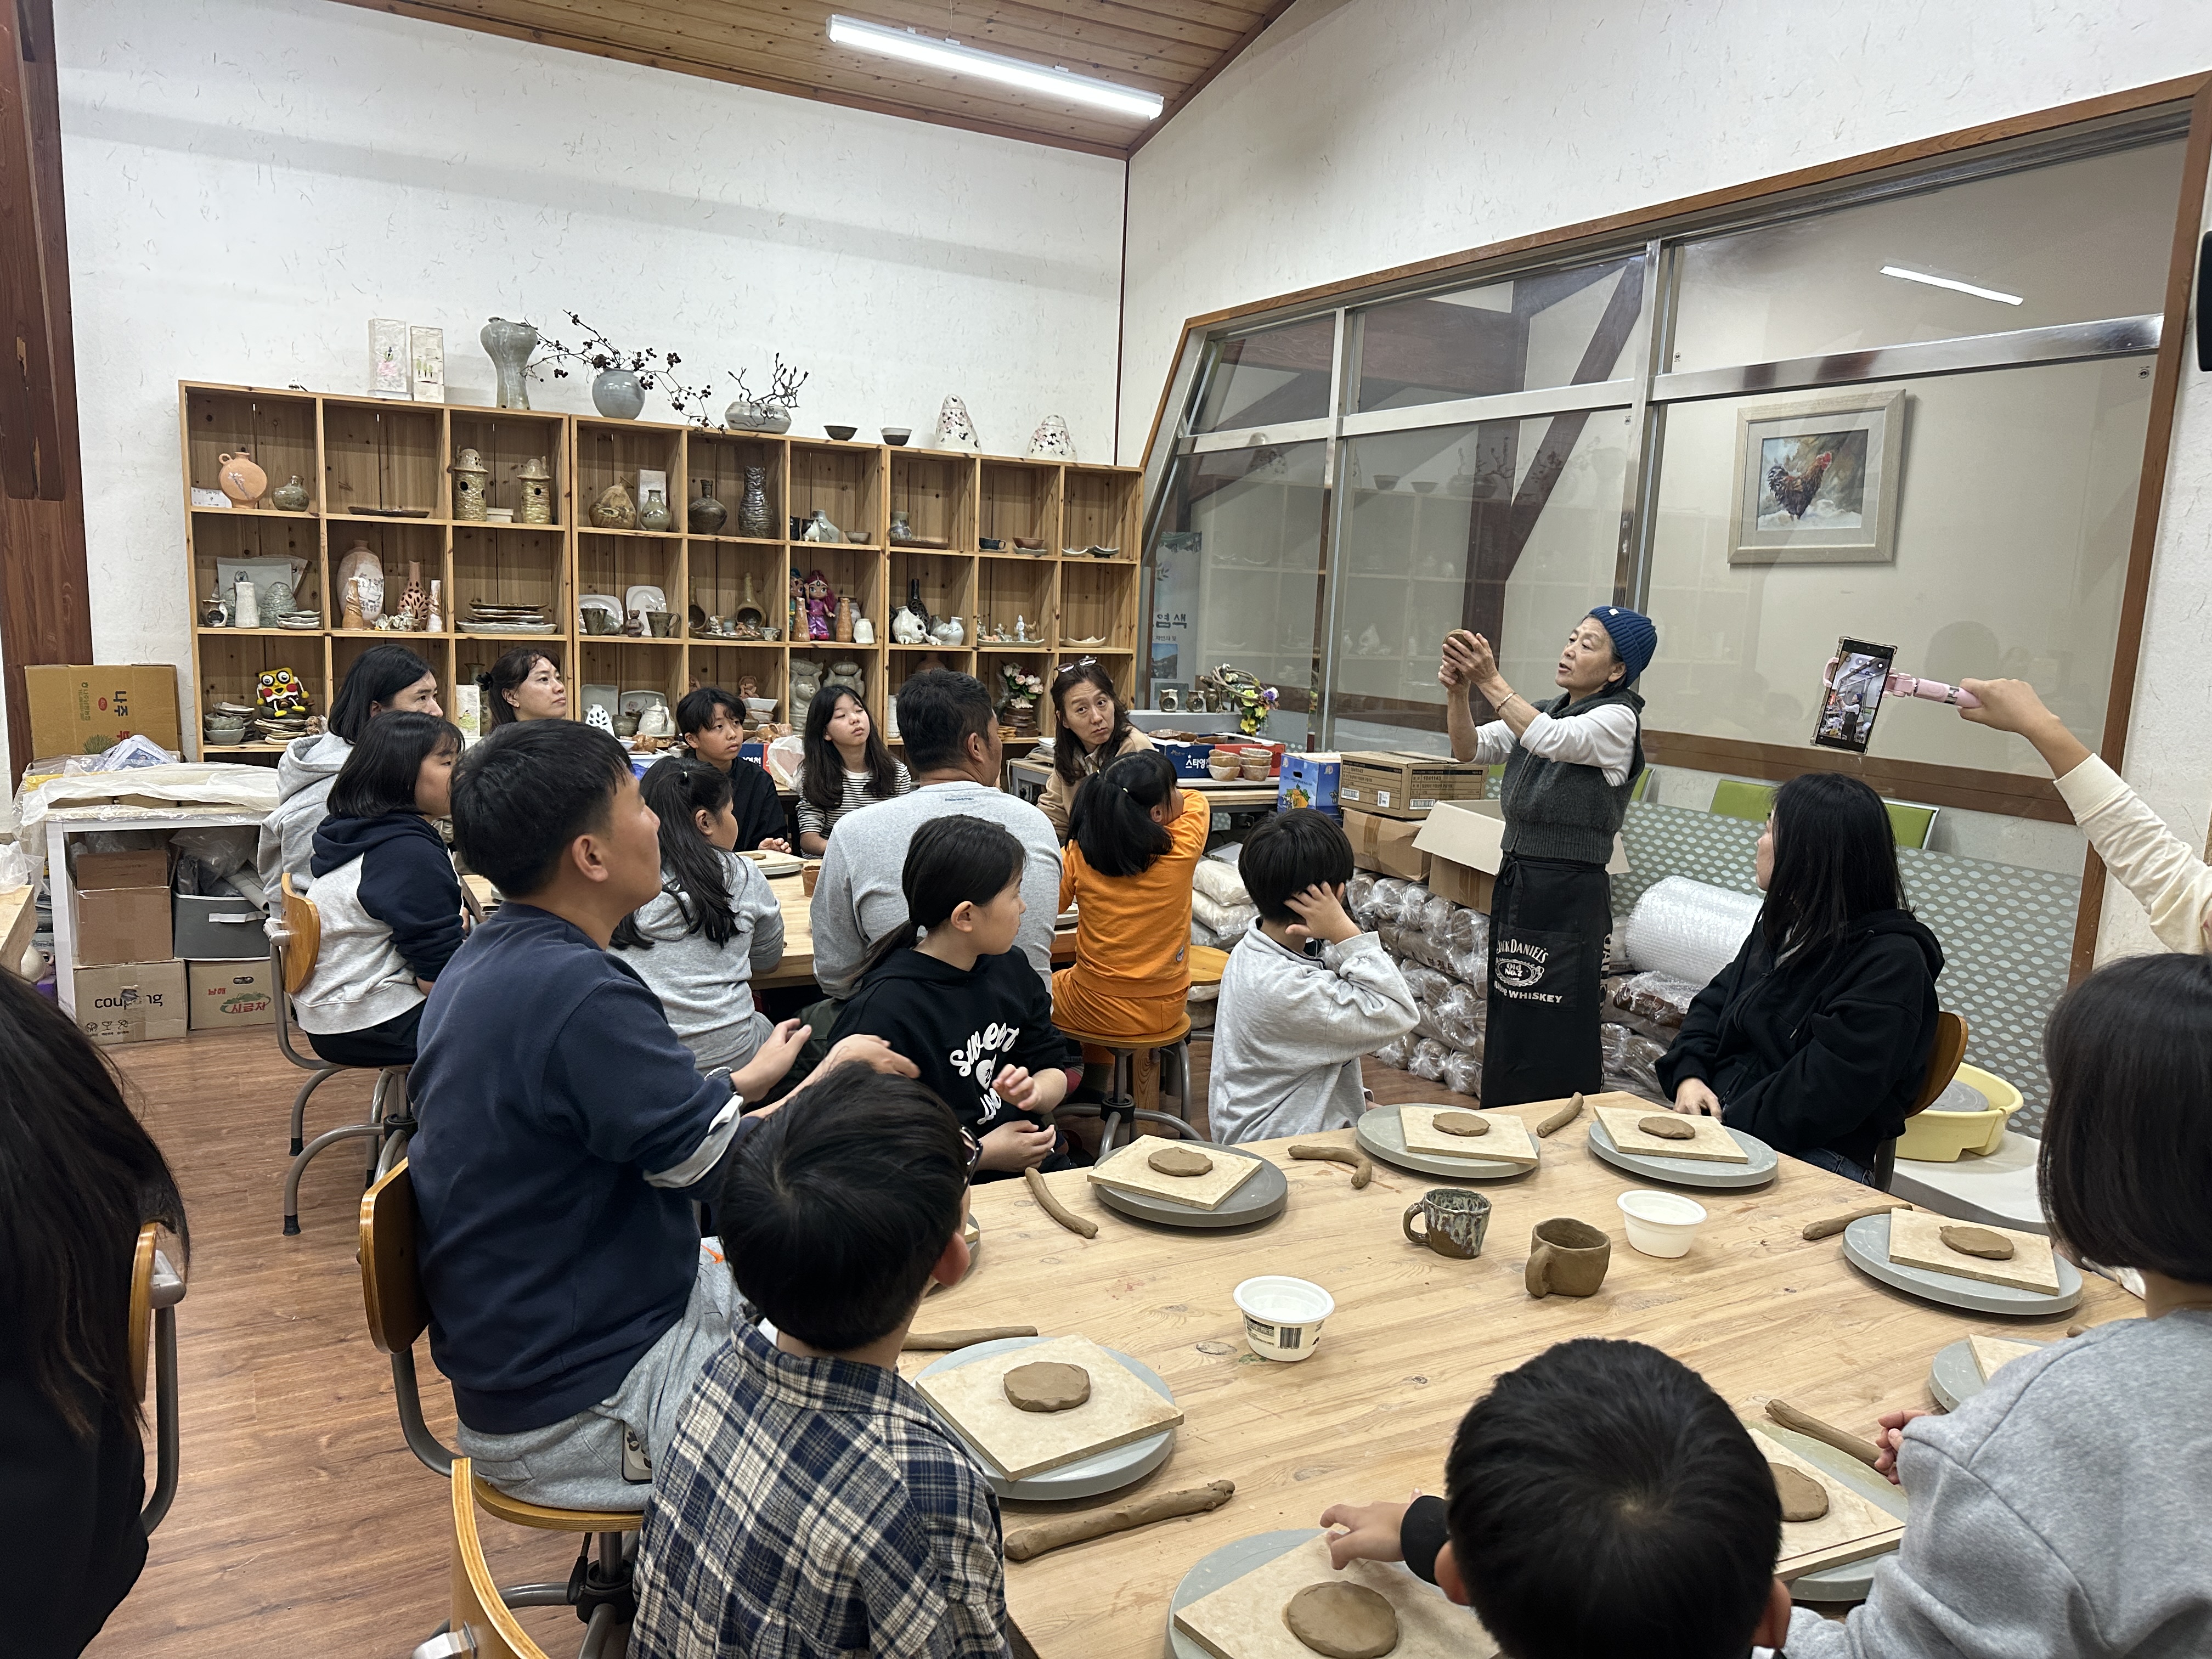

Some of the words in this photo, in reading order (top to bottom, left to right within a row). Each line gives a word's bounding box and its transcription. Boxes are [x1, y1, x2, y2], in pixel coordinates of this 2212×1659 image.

[1152, 613, 1187, 629] 염색
[113, 691, 128, 716] 나주
[1509, 990, 1562, 1003] WHISKEY
